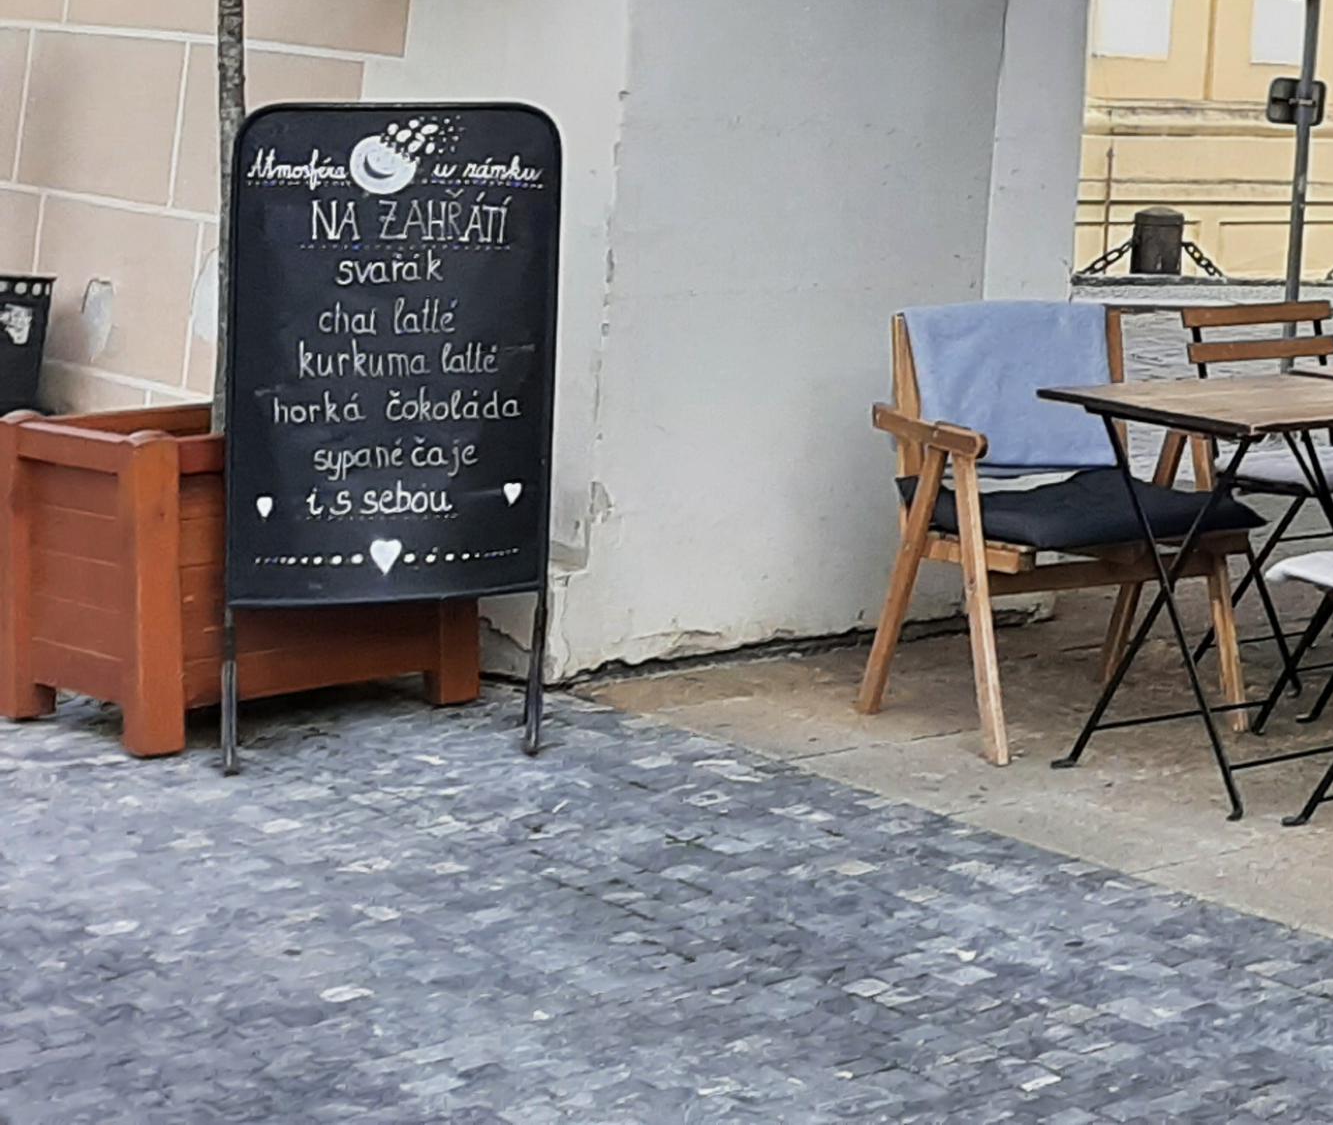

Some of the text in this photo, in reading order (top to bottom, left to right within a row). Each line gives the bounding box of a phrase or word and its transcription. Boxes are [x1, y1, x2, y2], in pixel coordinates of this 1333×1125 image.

[247, 148, 349, 190] Atmosféra
[311, 189, 512, 244] NA ZAHŘÁTÍ
[335, 249, 444, 287] svařák
[299, 338, 499, 379] kurkuma latté
[273, 386, 522, 424] horká čokoláda
[313, 435, 481, 481] sypané čaje
[359, 479, 455, 515] sebou
